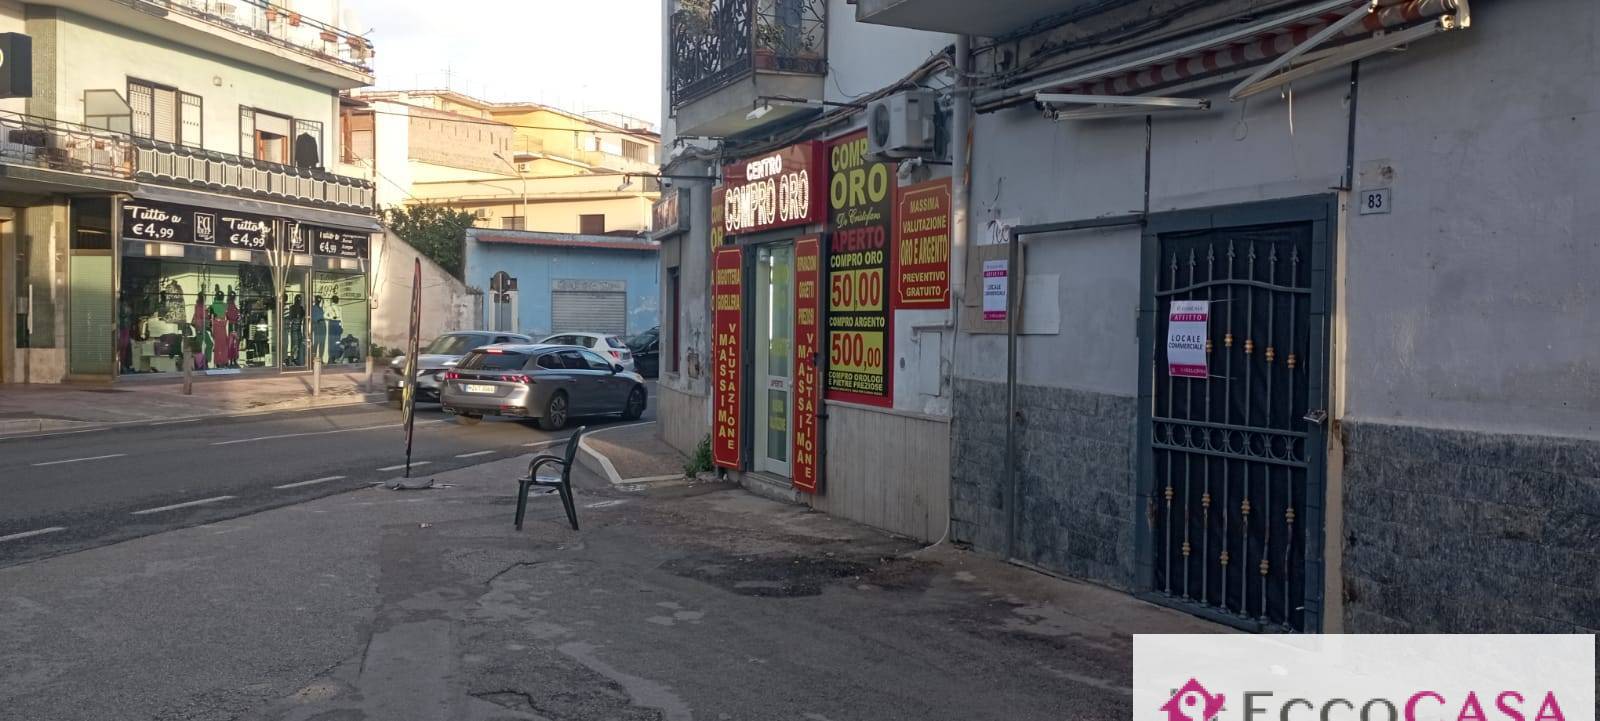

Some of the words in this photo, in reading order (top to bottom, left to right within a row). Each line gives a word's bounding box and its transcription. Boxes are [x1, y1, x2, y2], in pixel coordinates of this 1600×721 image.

[832, 138, 868, 172] COMP
[746, 154, 782, 181] CENTRO
[831, 163, 887, 209] ORO
[725, 178, 775, 231] COMPRO
[780, 169, 808, 221] ORO
[910, 197, 939, 213] MASSIMA
[1368, 194, 1382, 208] 83
[123, 205, 169, 221] Tutto
[171, 215, 181, 223] a
[132, 223, 174, 238] €4,99
[222, 217, 259, 232] Tutto
[903, 215, 947, 233] VALUTAZIONE
[230, 233, 265, 248] €4,99
[832, 225, 885, 252] APERTO
[830, 253, 862, 268] COMPRO
[864, 250, 883, 265] ORO
[901, 239, 913, 266] ORO
[914, 239, 919, 265] E
[919, 235, 948, 264] ARGENTO
[902, 271, 945, 283] PREVENTIVO
[906, 286, 941, 297] GRATUITO
[829, 317, 853, 327] COMPRO
[854, 316, 885, 328] ARGENTO
[832, 333, 881, 371] 500,00
[1168, 342, 1203, 350] COMMERCIALE
[718, 333, 727, 438] MASSIMA
[829, 371, 853, 380] COMPRO
[854, 374, 883, 383] OROLOGI
[833, 379, 853, 387] PIETRE
[853, 381, 883, 391] PREZIOSE
[728, 323, 737, 450] VALUTAZIONE
[797, 345, 806, 464] MASSIMA
